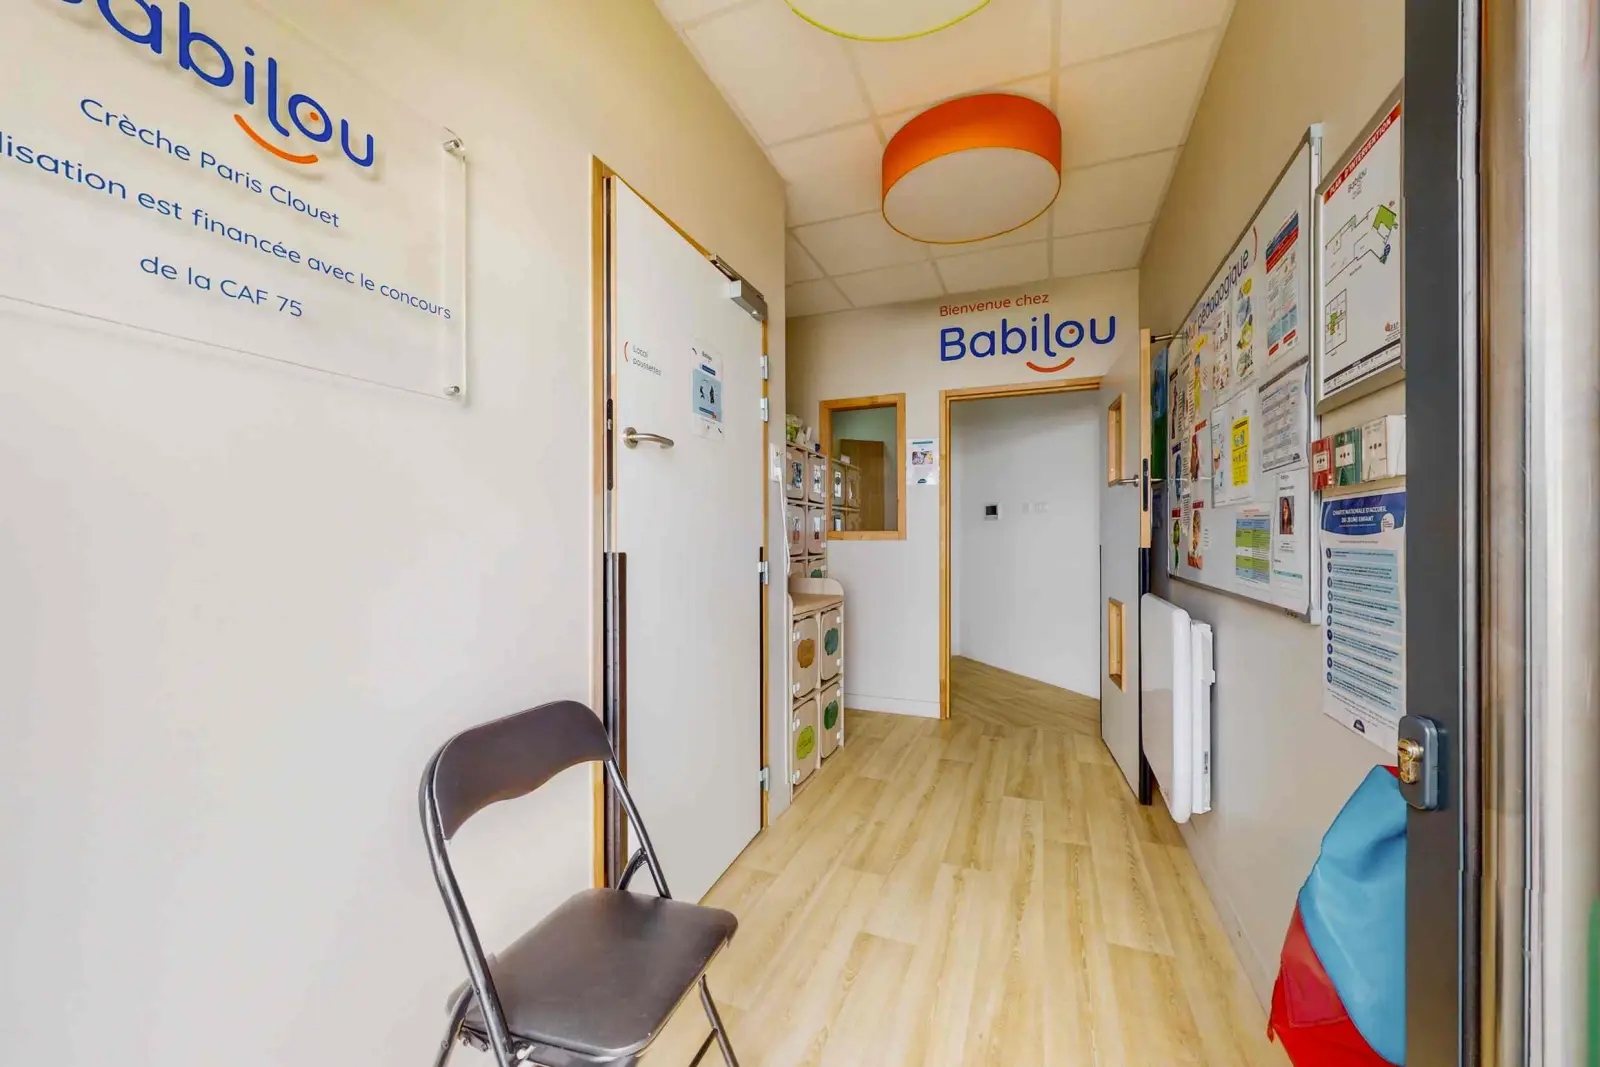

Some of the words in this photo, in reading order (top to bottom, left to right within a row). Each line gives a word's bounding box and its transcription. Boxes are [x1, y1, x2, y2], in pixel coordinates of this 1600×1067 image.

[62, 0, 375, 168] abilou
[80, 98, 191, 162] Crèche
[200, 151, 262, 194] Paris
[269, 185, 340, 228] Clouet
[1328, 176, 1342, 196] PLAN
[0, 131, 127, 200] lisation
[137, 191, 183, 220] est
[191, 208, 302, 264] financée
[307, 257, 356, 285] avec
[360, 262, 376, 291] le
[380, 282, 452, 320] concours
[139, 256, 178, 280] de
[187, 267, 212, 291] la
[220, 278, 268, 306] CAF
[276, 295, 303, 318] 75
[940, 298, 1011, 317] Bienvenue
[1015, 294, 1049, 307] chez
[940, 313, 1116, 362] Babilou
